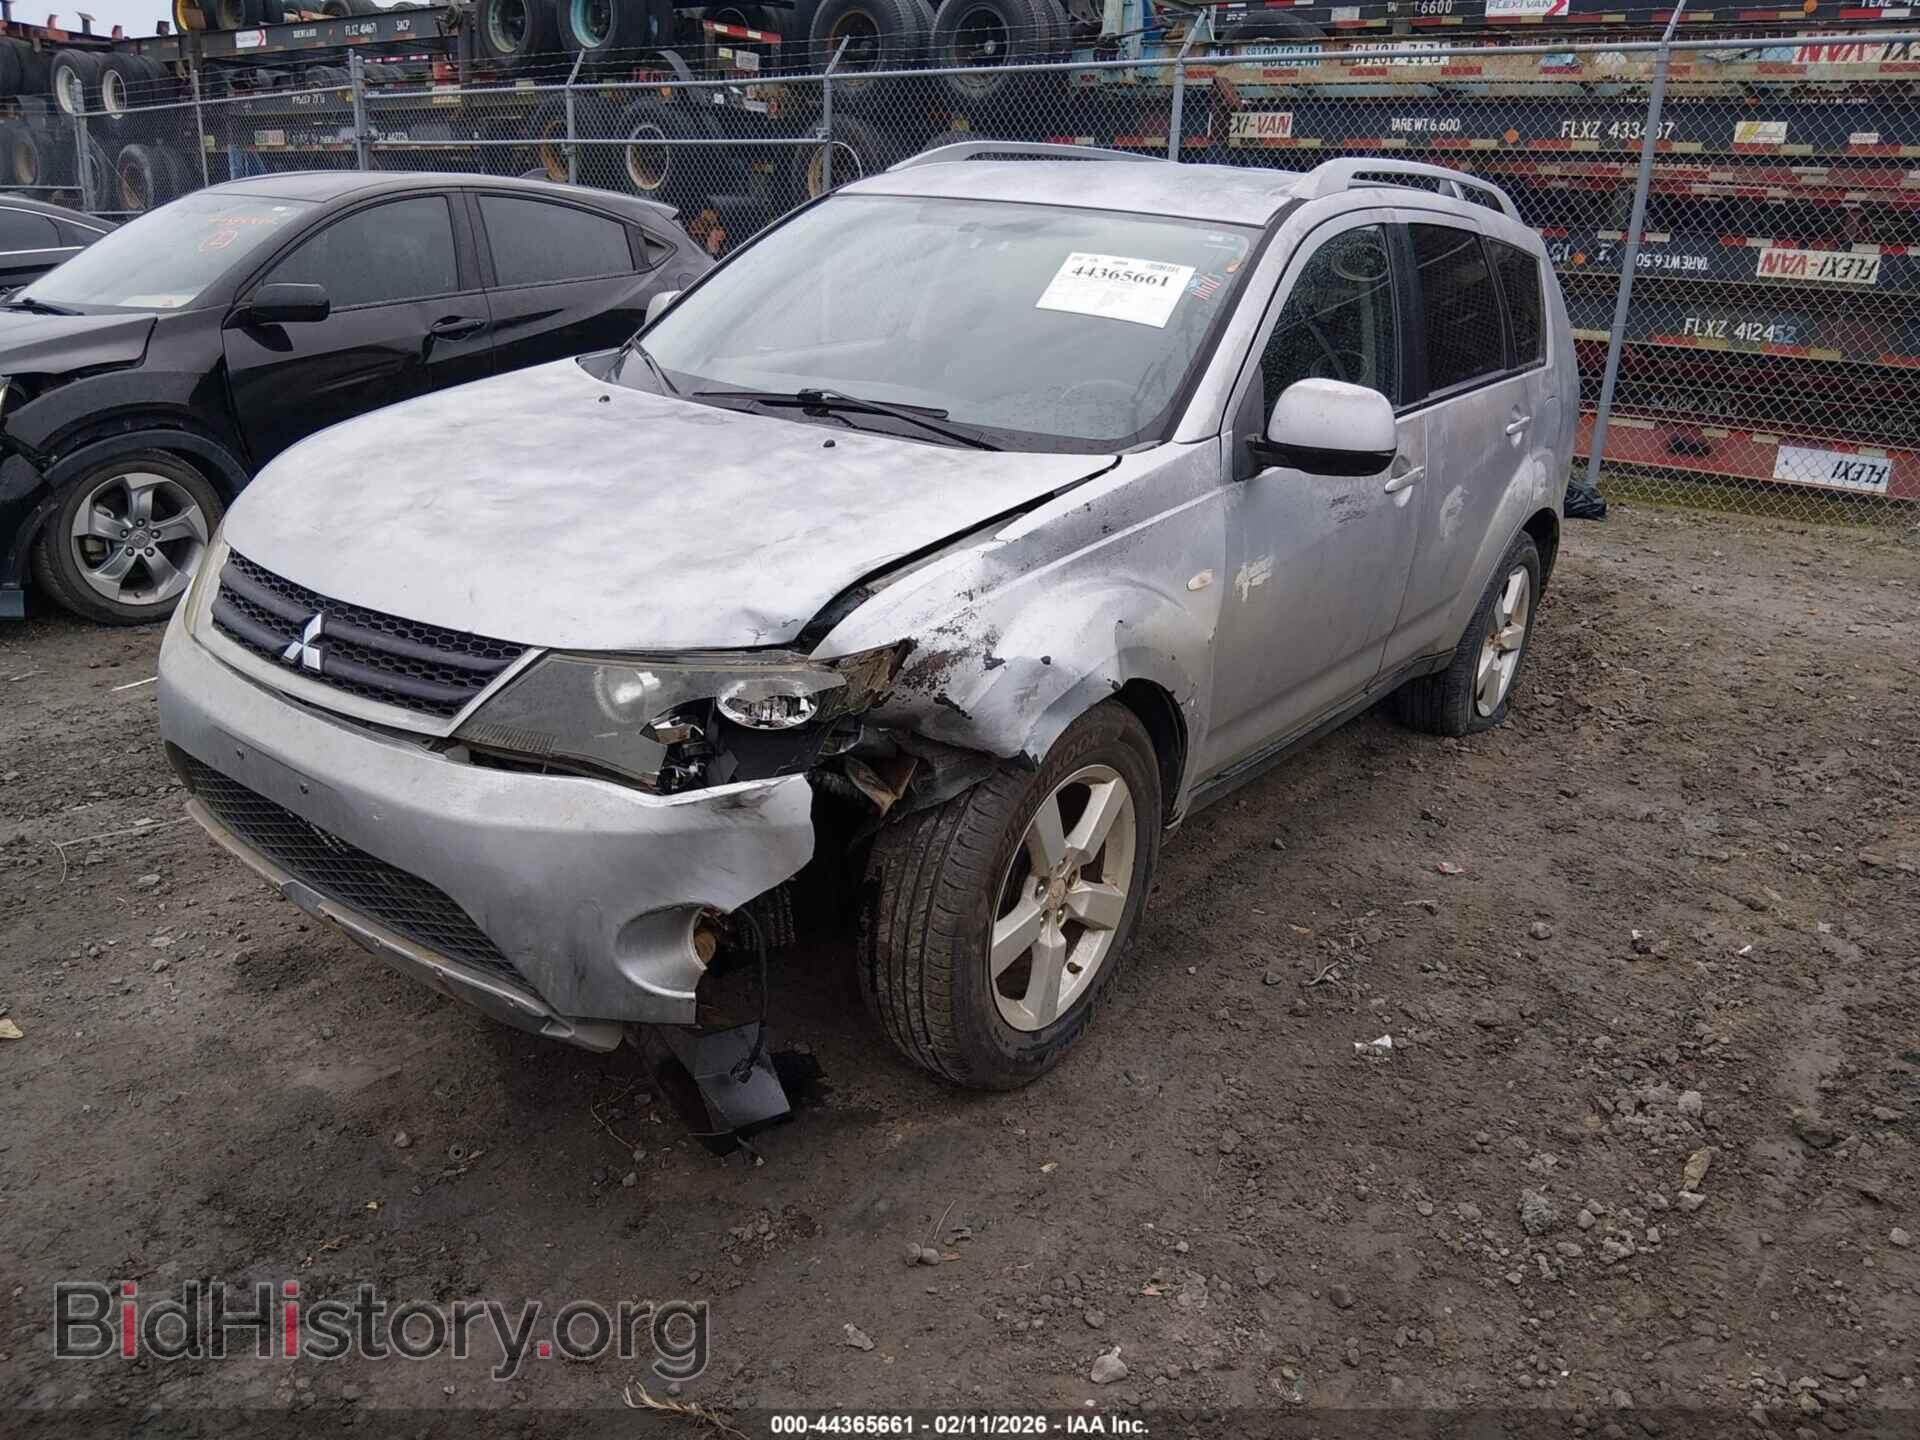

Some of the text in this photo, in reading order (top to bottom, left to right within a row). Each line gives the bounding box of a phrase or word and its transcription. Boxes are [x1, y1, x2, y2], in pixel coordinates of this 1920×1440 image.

[1561, 119, 1601, 139] FLXZ
[1071, 264, 1169, 287] 44365661
[1760, 252, 1879, 280] FLEXI-VAN
[1683, 317, 1728, 338] FLXZ
[1831, 460, 1888, 484] FLEXI
